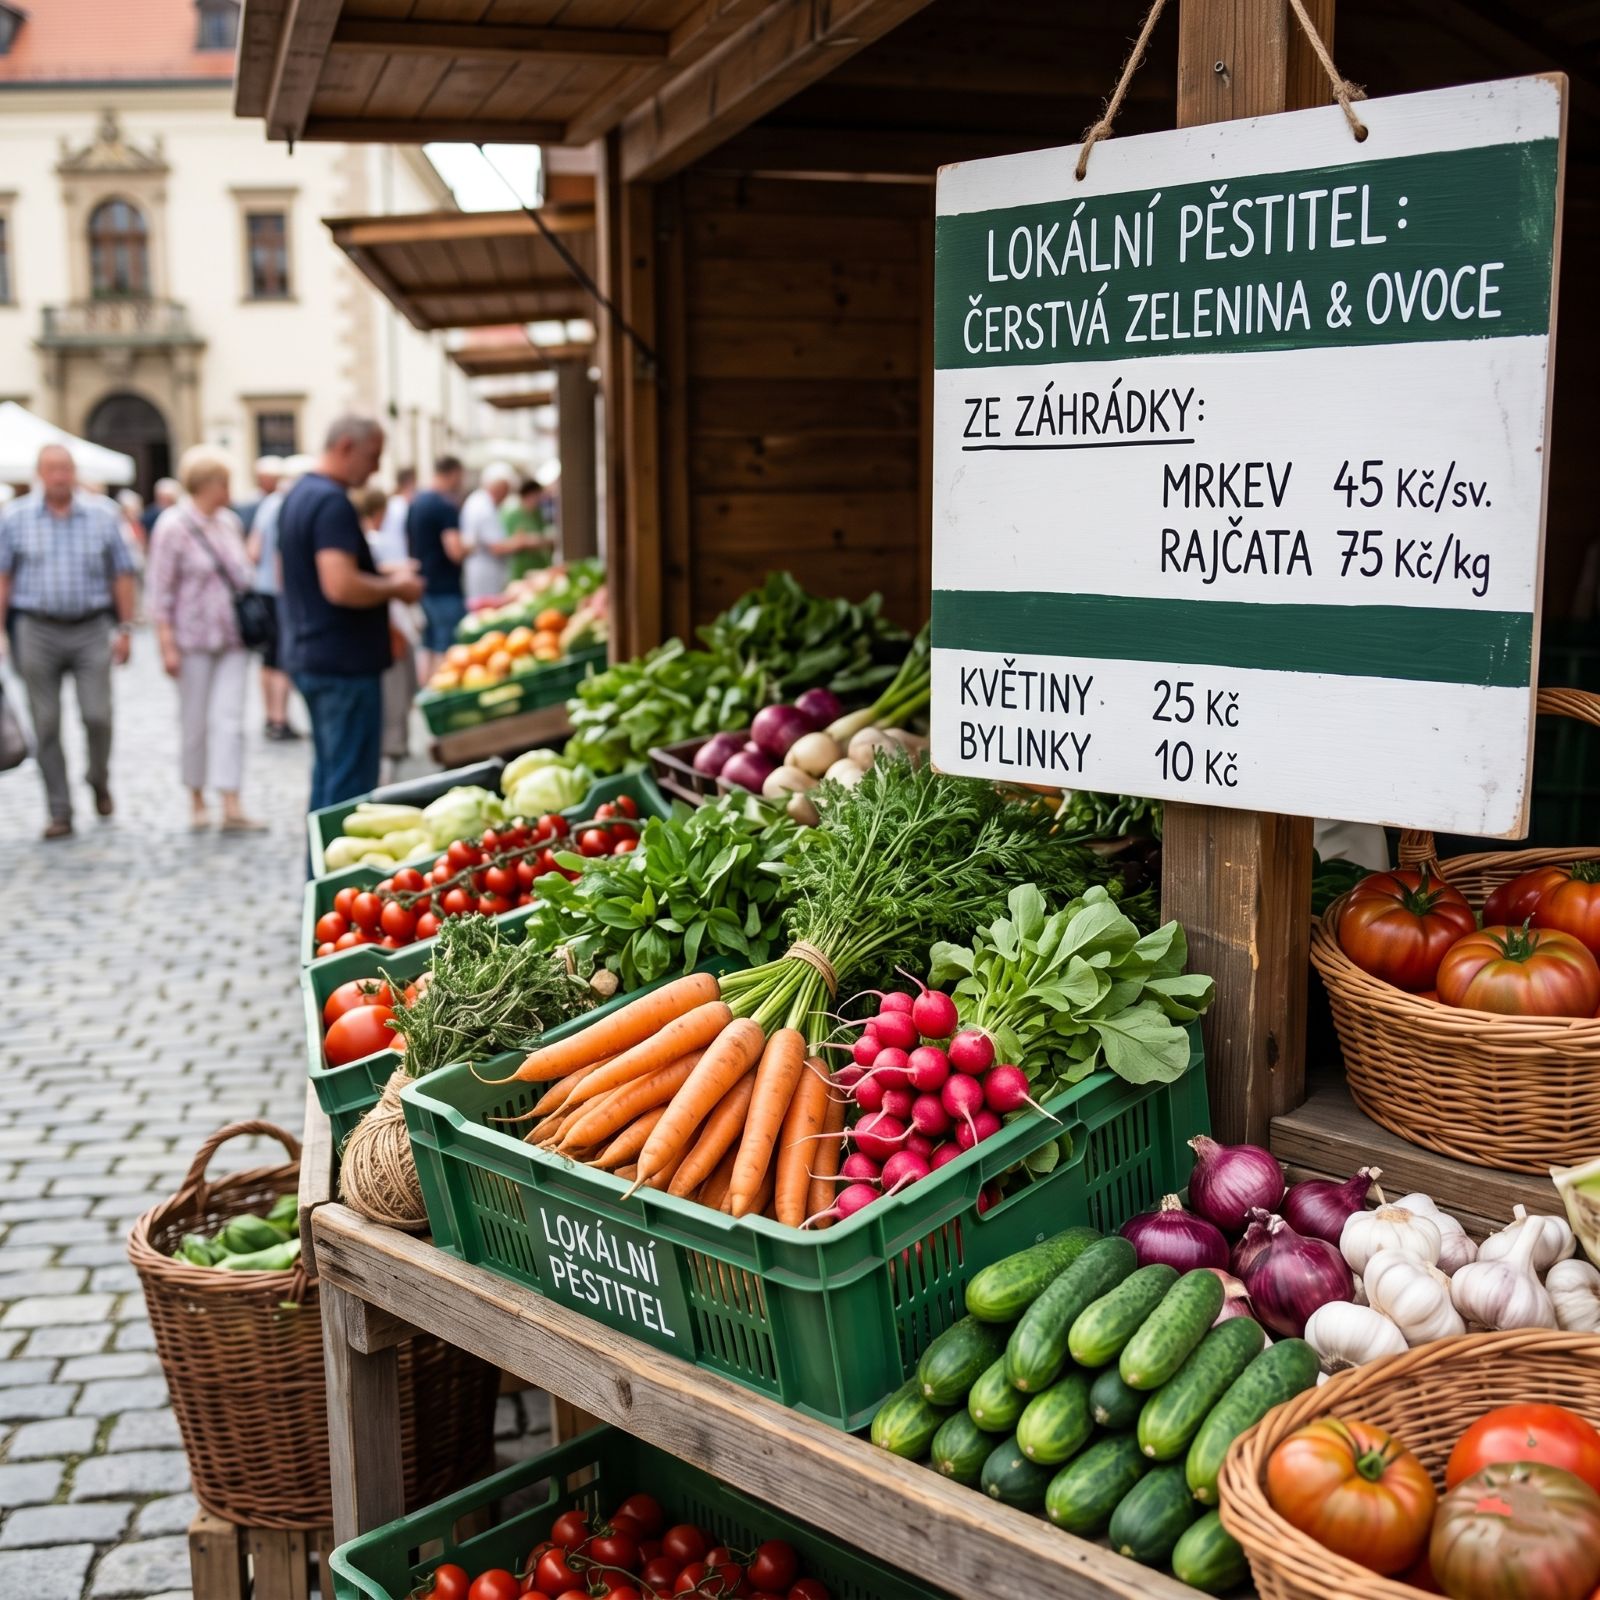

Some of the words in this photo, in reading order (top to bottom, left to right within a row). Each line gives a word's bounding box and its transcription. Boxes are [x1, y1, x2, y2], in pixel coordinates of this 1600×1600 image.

[988, 192, 1162, 283] LOKÁLNÍ
[963, 281, 1110, 354] ČERSTVÁ
[1124, 279, 1311, 343] ZELENINA
[1326, 280, 1352, 329] &
[1366, 262, 1505, 325] OVOCE
[963, 396, 1001, 438] ZE
[1014, 376, 1206, 437] ZÁHRÁDKY:
[1163, 461, 1293, 509] MRKEV
[1333, 459, 1384, 508] 45
[1397, 460, 1492, 514] Kč/sv.
[1161, 515, 1313, 585] RAJČATA
[1336, 530, 1383, 578] 75
[1395, 532, 1490, 598] Kč/kg
[960, 657, 1094, 716] KVĚTINY
[1152, 679, 1195, 724] 25
[1206, 689, 1240, 728] Kč
[960, 721, 1092, 773] BYLINKY
[1154, 739, 1194, 782] 10
[1205, 749, 1238, 788] Kč
[540, 1207, 659, 1286] LOKÁLNÍ
[549, 1252, 676, 1338] PĚSTITEL
